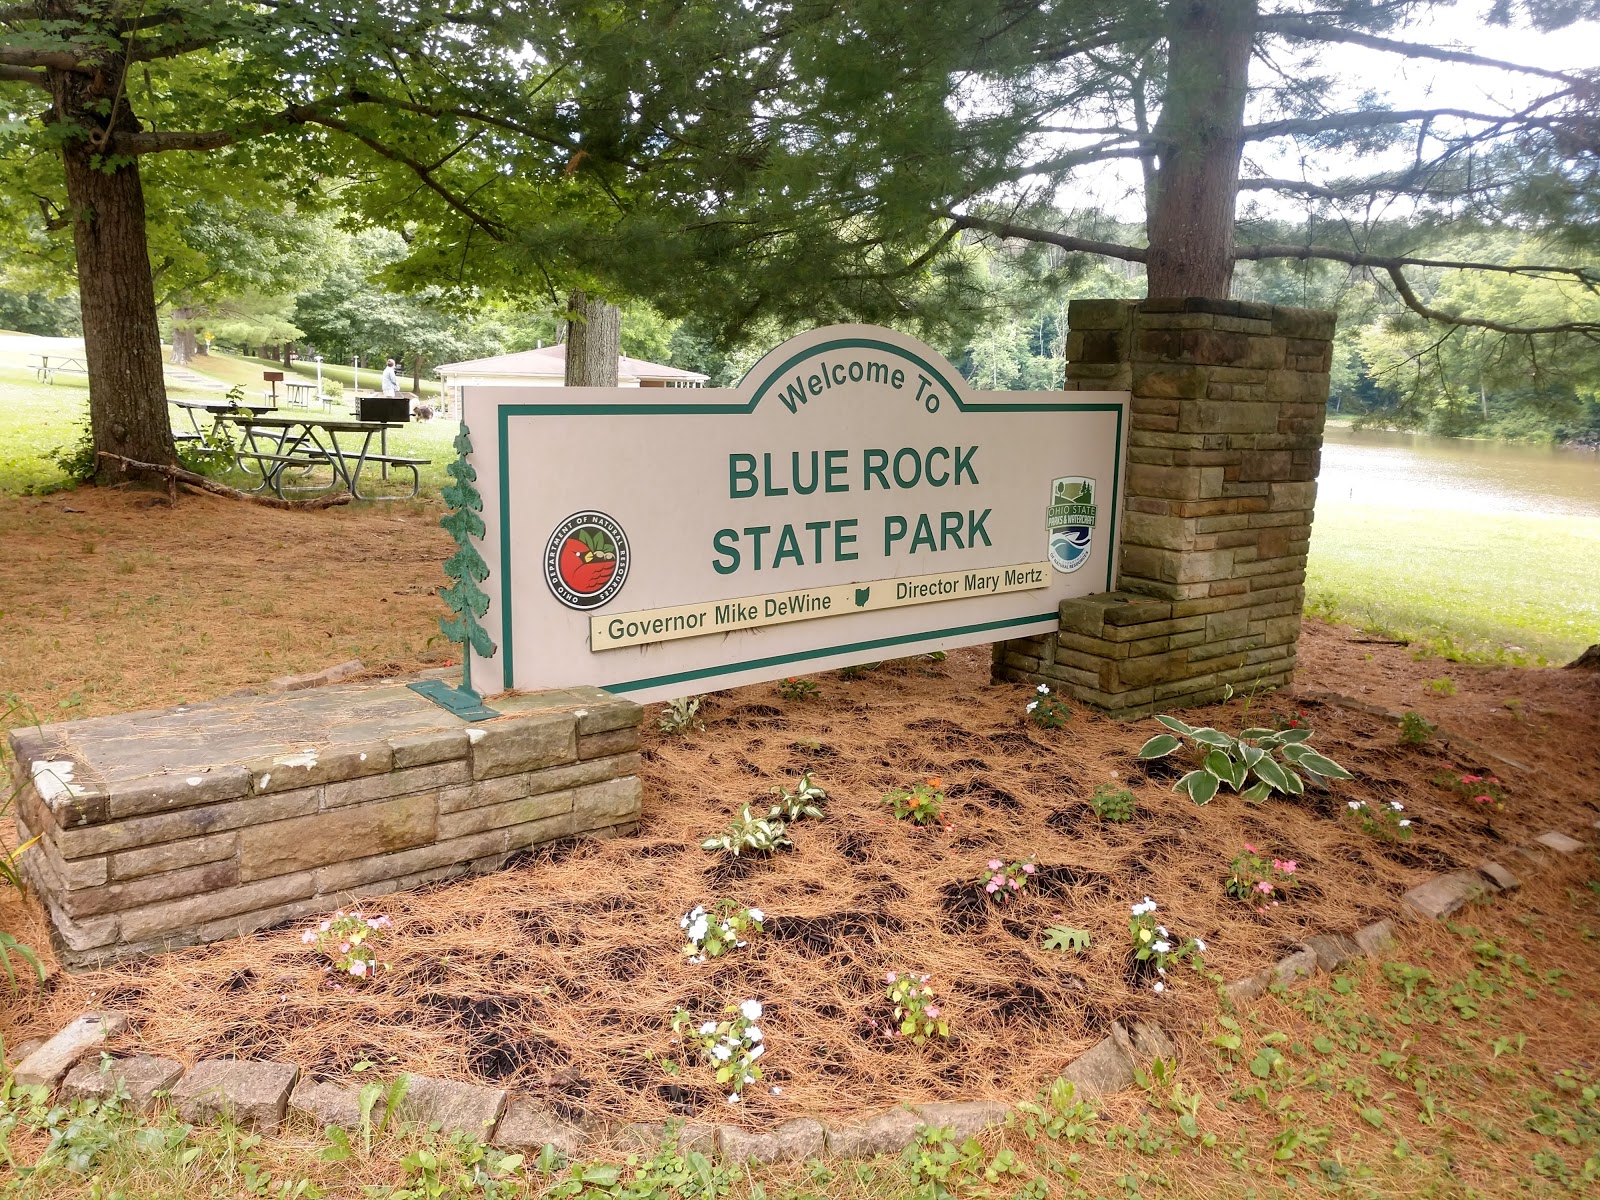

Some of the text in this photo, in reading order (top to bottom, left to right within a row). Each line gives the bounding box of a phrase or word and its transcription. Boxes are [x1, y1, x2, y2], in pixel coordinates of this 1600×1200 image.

[778, 361, 940, 414] Welcome To
[729, 446, 979, 499] BLUE ROCK
[592, 517, 624, 546] NATURAL
[1049, 505, 1095, 517] OHIO STATE
[549, 523, 573, 584] DEPARTMENT
[712, 509, 992, 575] STATE PARK
[558, 586, 578, 603] OHIO
[599, 550, 626, 600] RESOURCES
[897, 568, 1043, 600] Director Mary Mertz
[608, 595, 832, 640] Governor Mike DeWine
